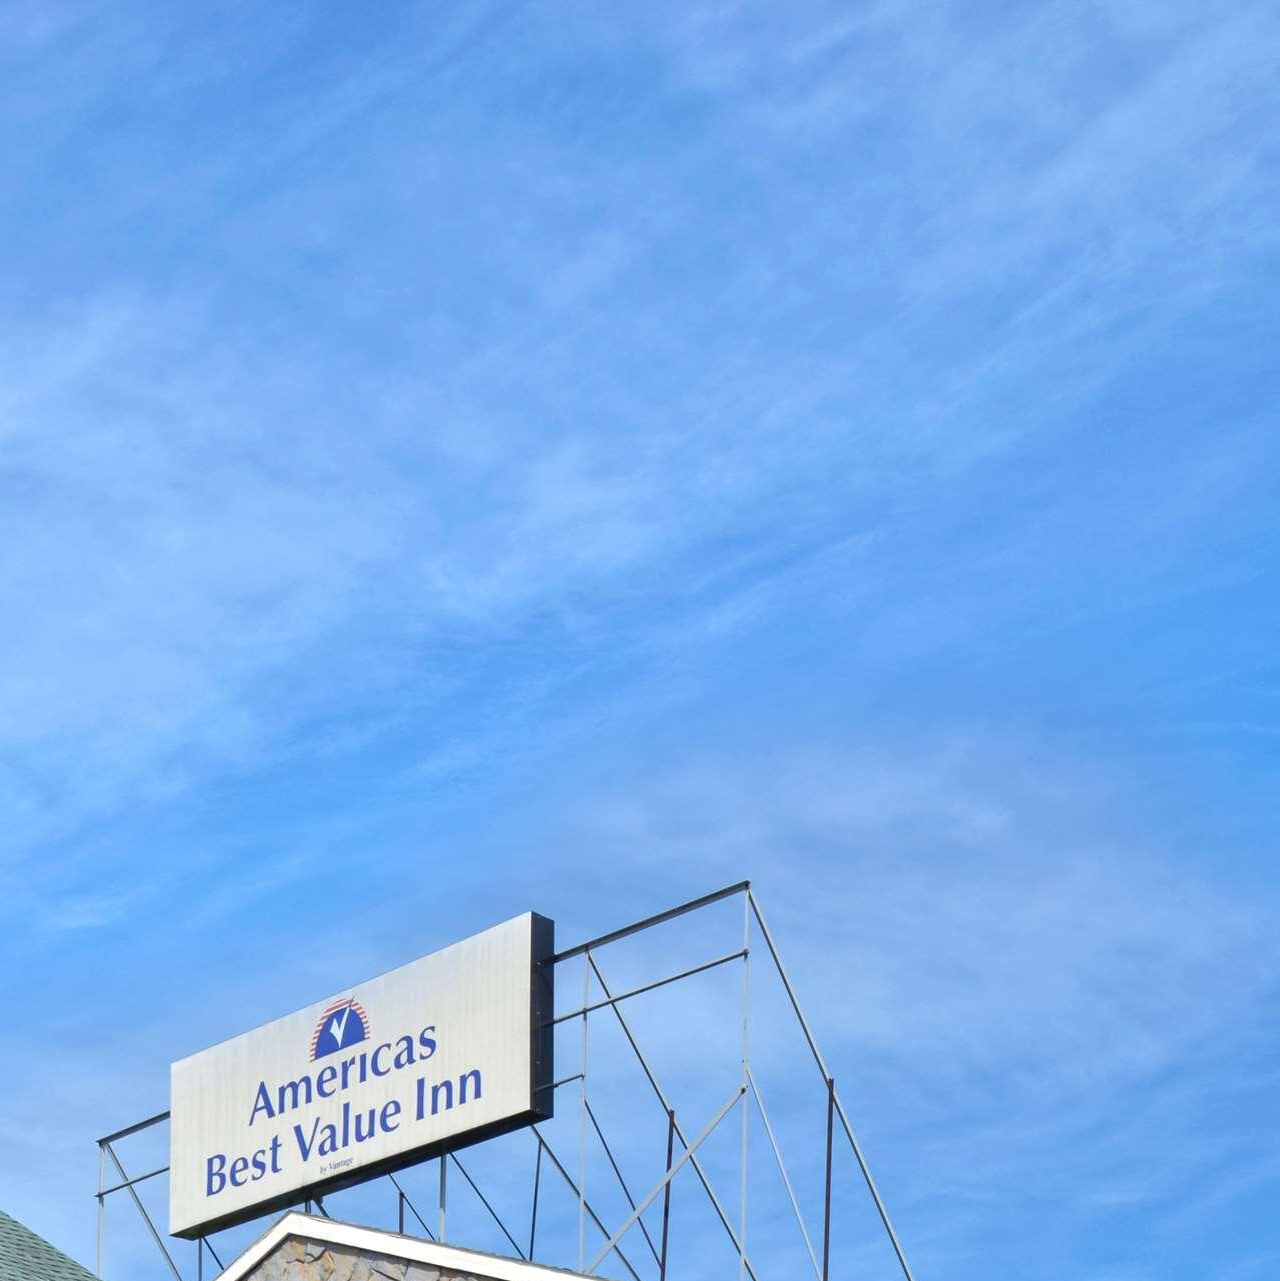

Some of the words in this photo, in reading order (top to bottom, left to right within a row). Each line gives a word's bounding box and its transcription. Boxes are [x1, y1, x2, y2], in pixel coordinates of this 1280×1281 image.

[206, 1134, 282, 1197] Best
[293, 1099, 401, 1162] Value
[416, 1068, 482, 1121] Inn
[248, 1025, 437, 1126] Americas
